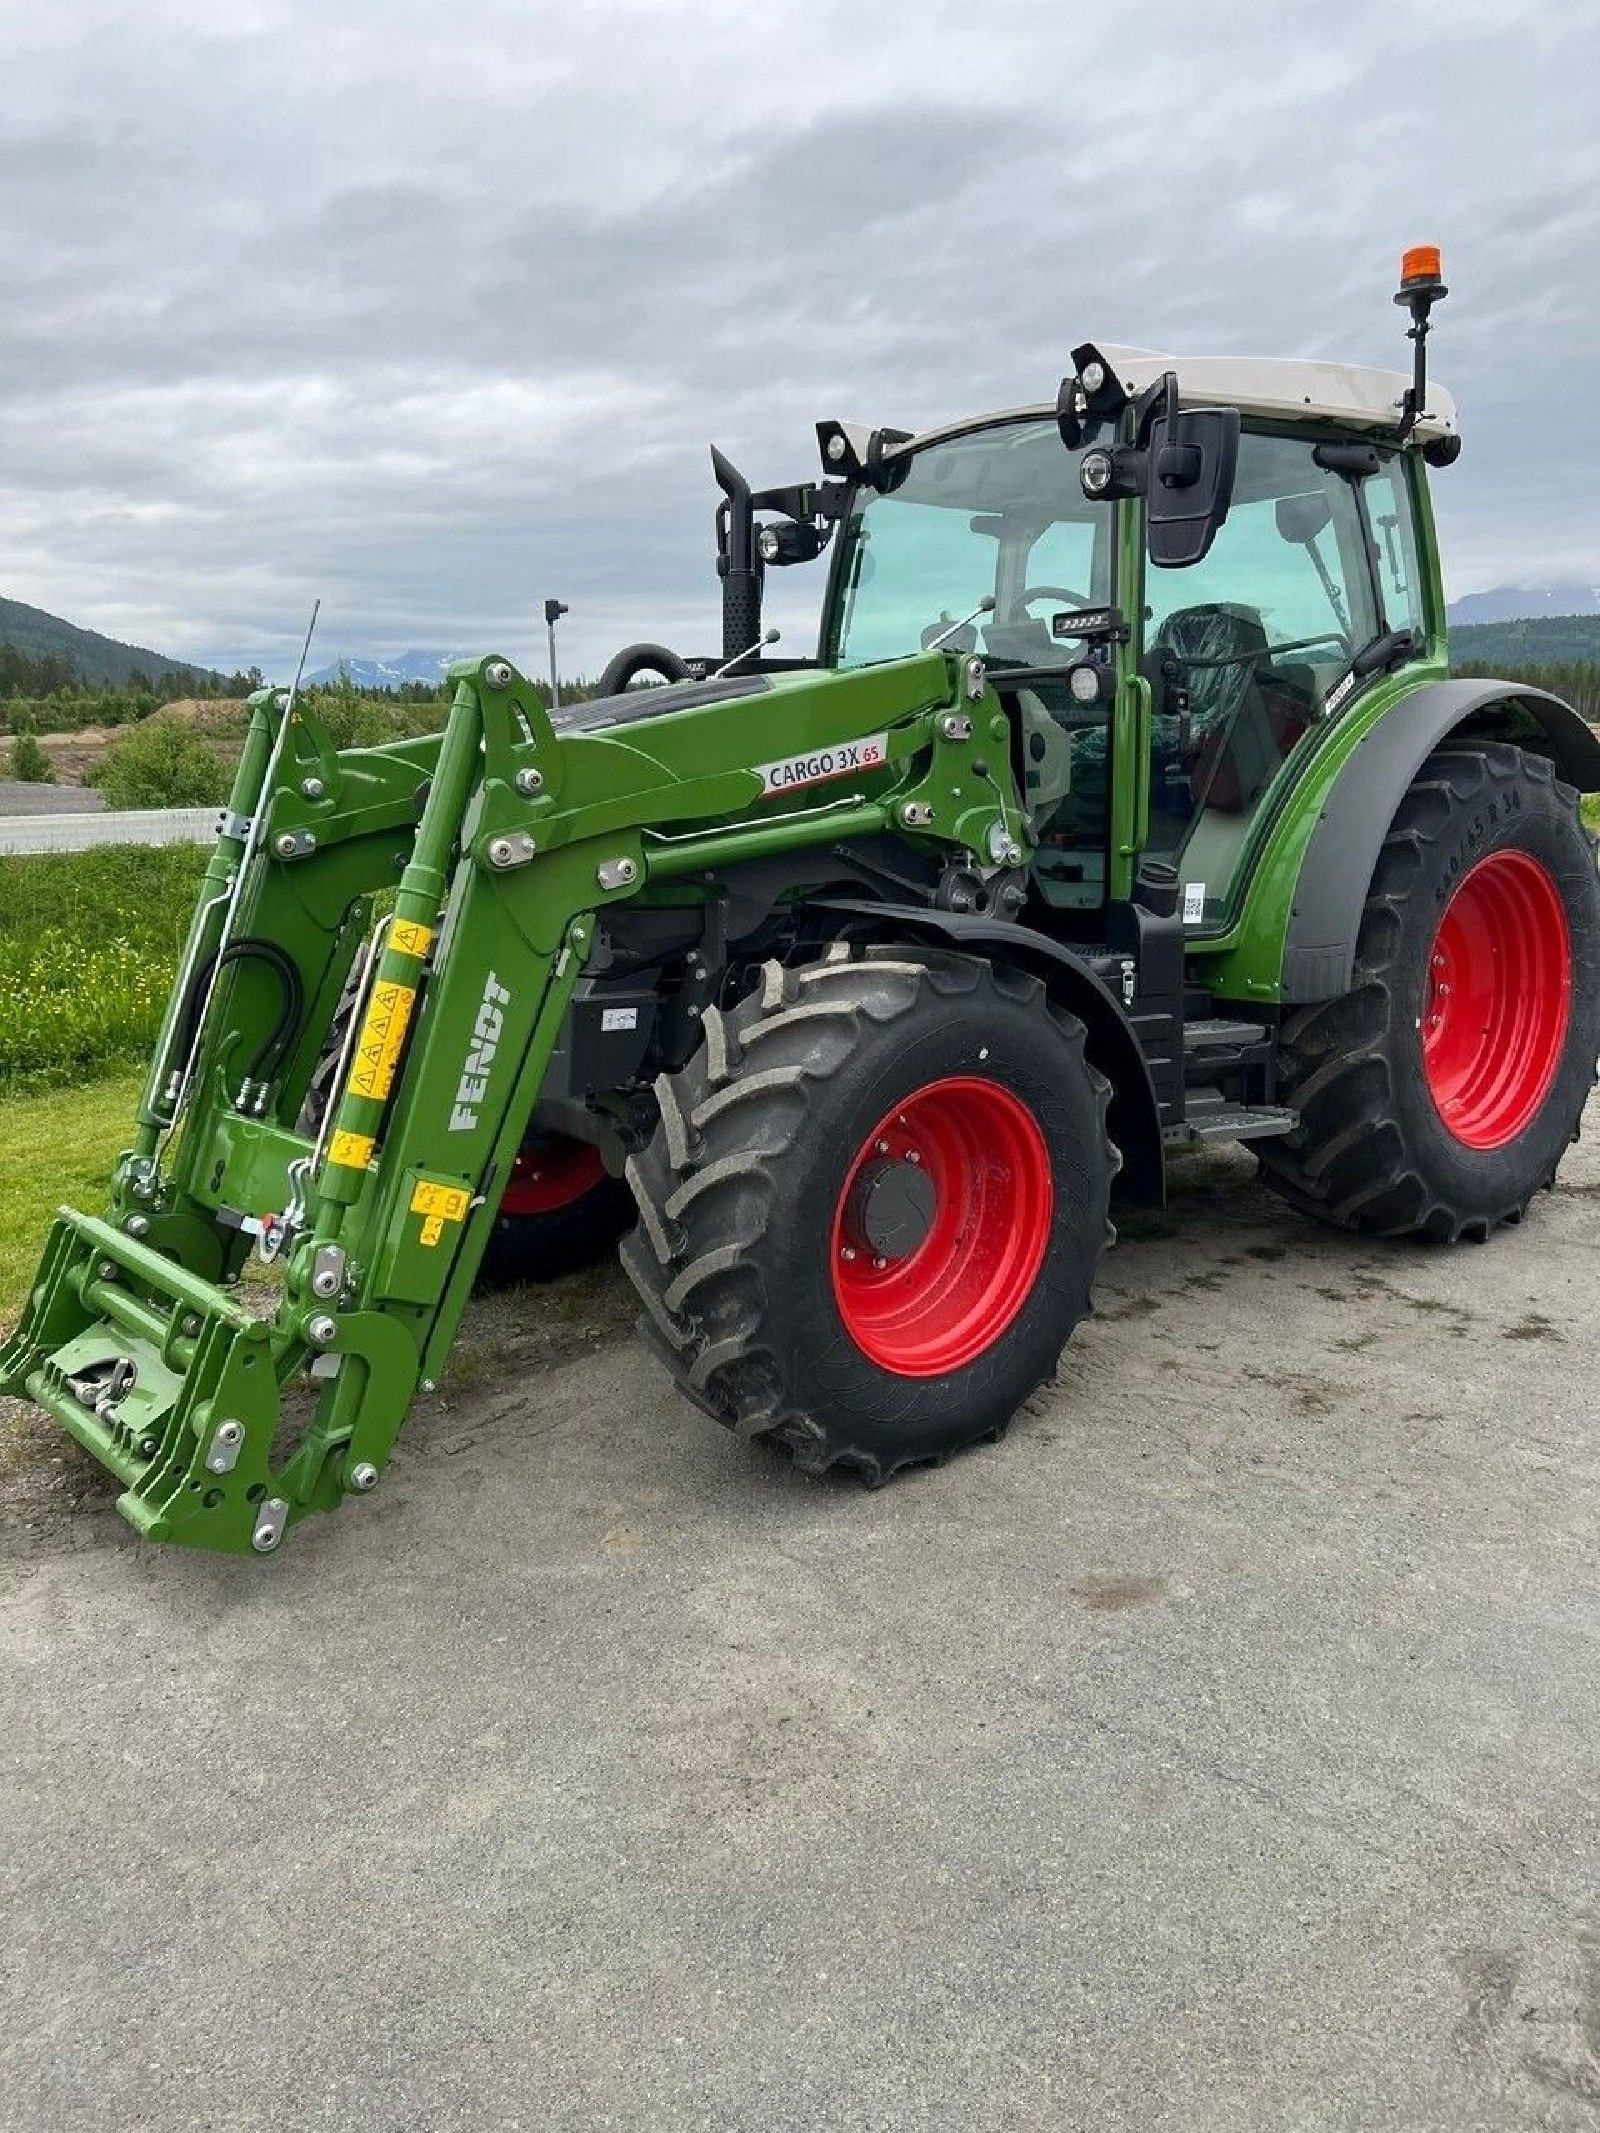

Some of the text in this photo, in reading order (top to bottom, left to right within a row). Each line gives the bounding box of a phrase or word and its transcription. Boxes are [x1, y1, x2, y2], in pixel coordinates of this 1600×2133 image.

[770, 745, 879, 787] CARGO 3X 65
[448, 970, 511, 1132] FENDT
